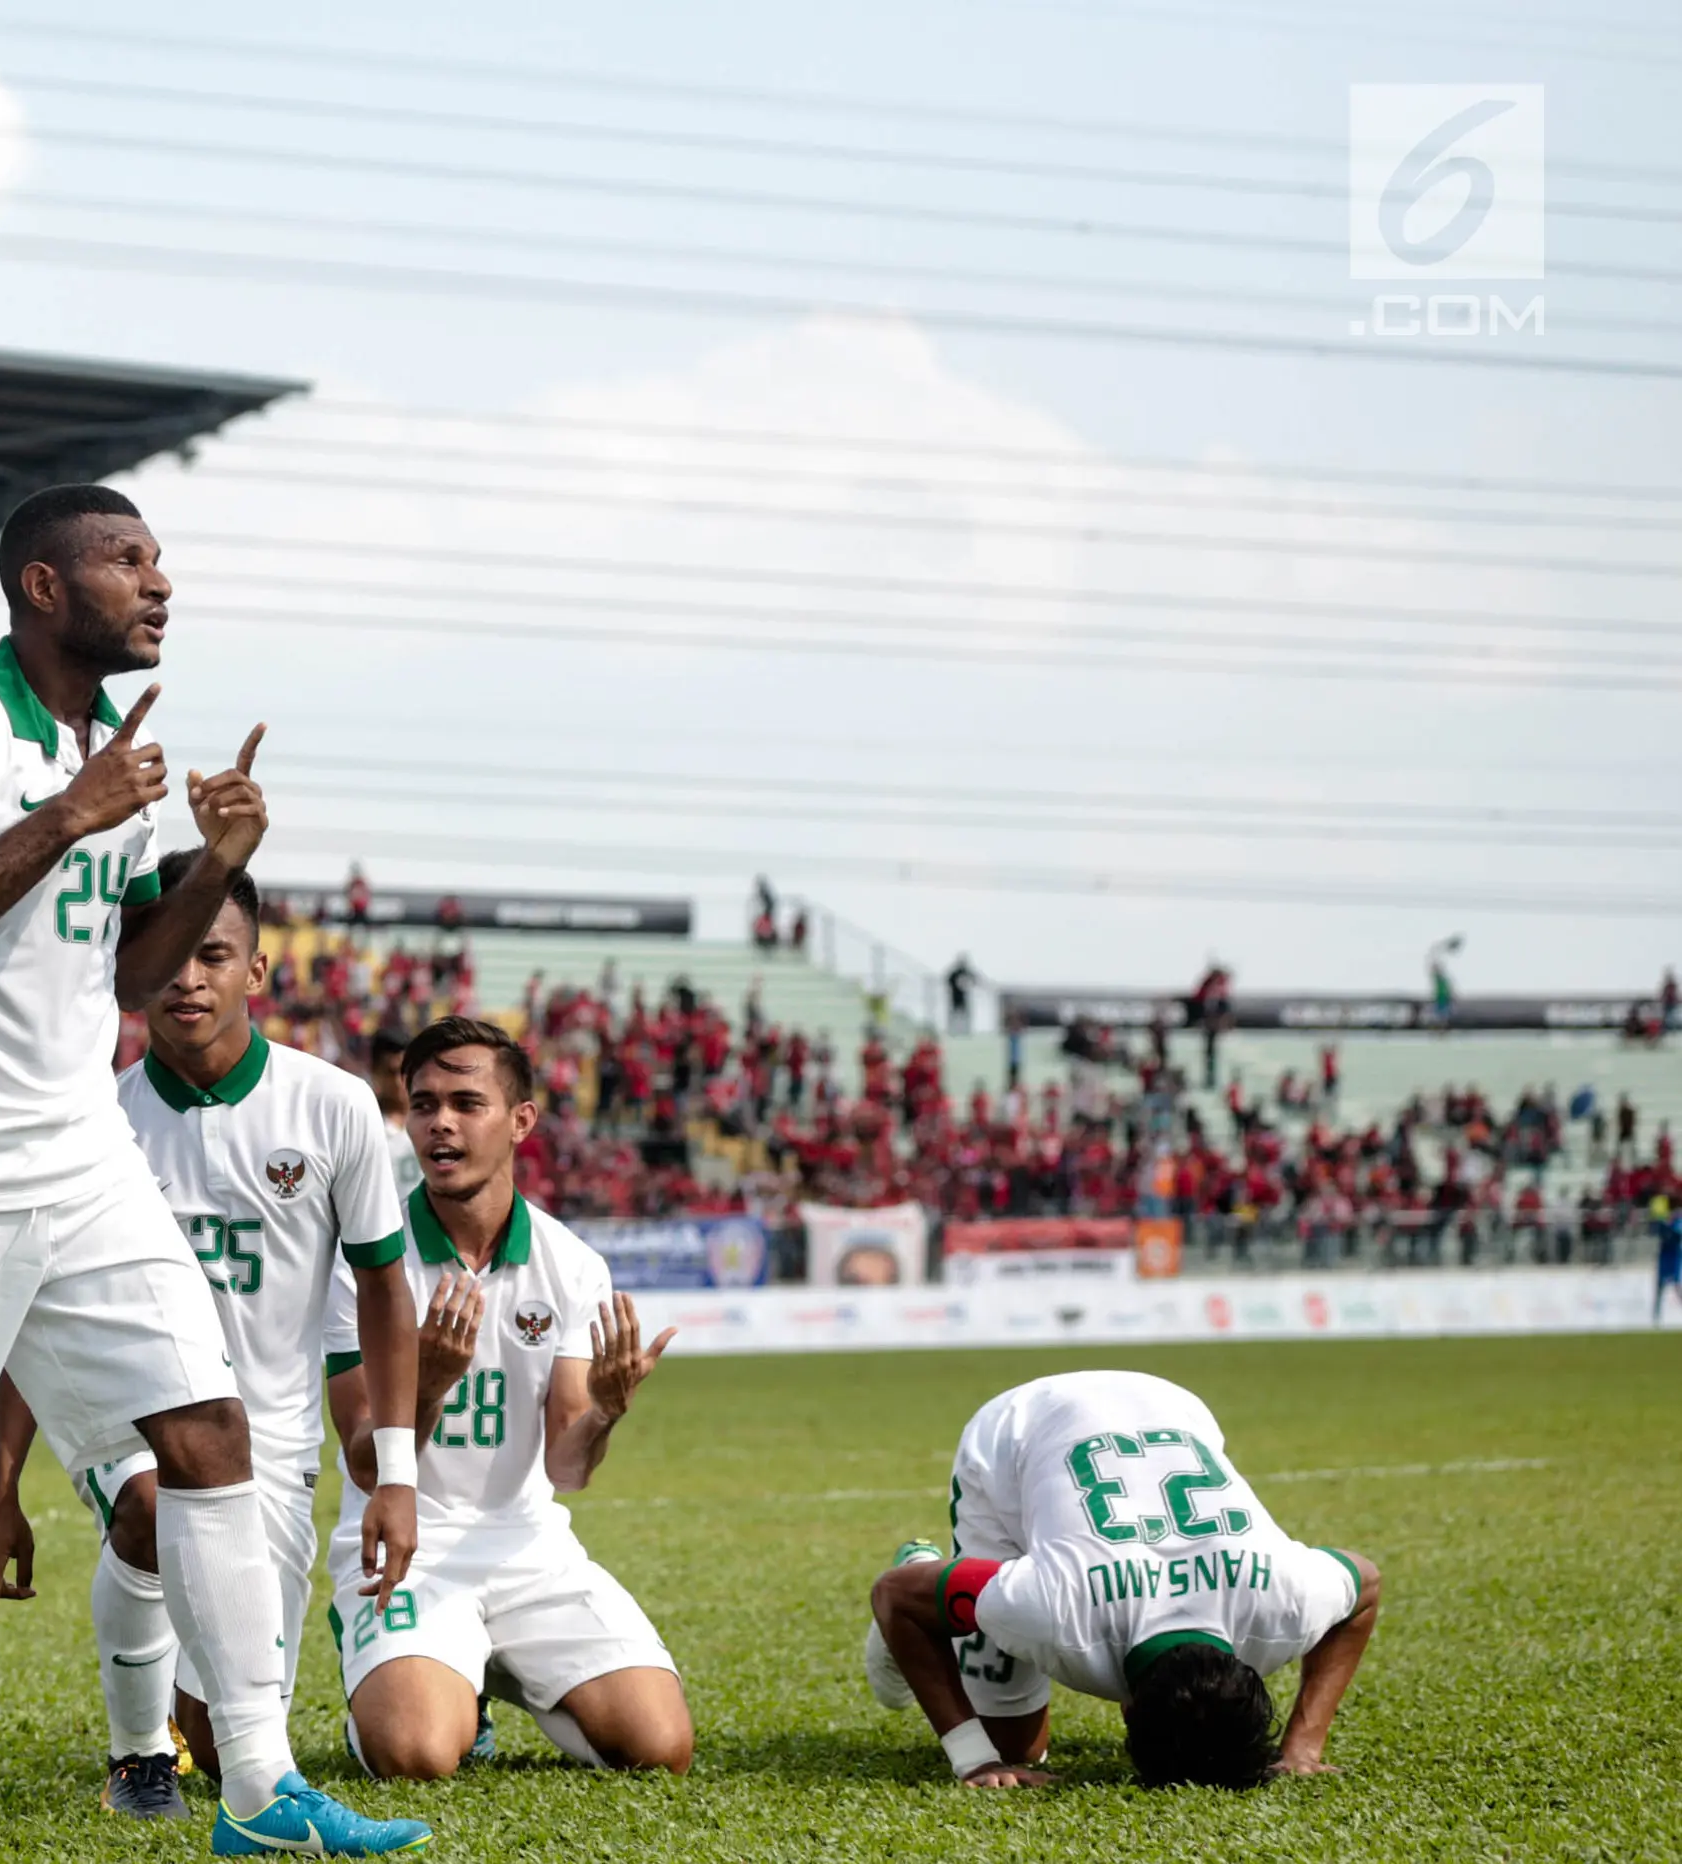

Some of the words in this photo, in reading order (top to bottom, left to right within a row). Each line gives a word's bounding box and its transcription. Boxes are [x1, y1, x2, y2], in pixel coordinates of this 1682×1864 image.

[53, 849, 131, 944] 24
[190, 1215, 264, 1295] 25
[430, 1368, 506, 1448] 28
[1064, 1428, 1253, 1545] 23
[1087, 1549, 1272, 1607] HANSAMU
[352, 1588, 418, 1654] 28
